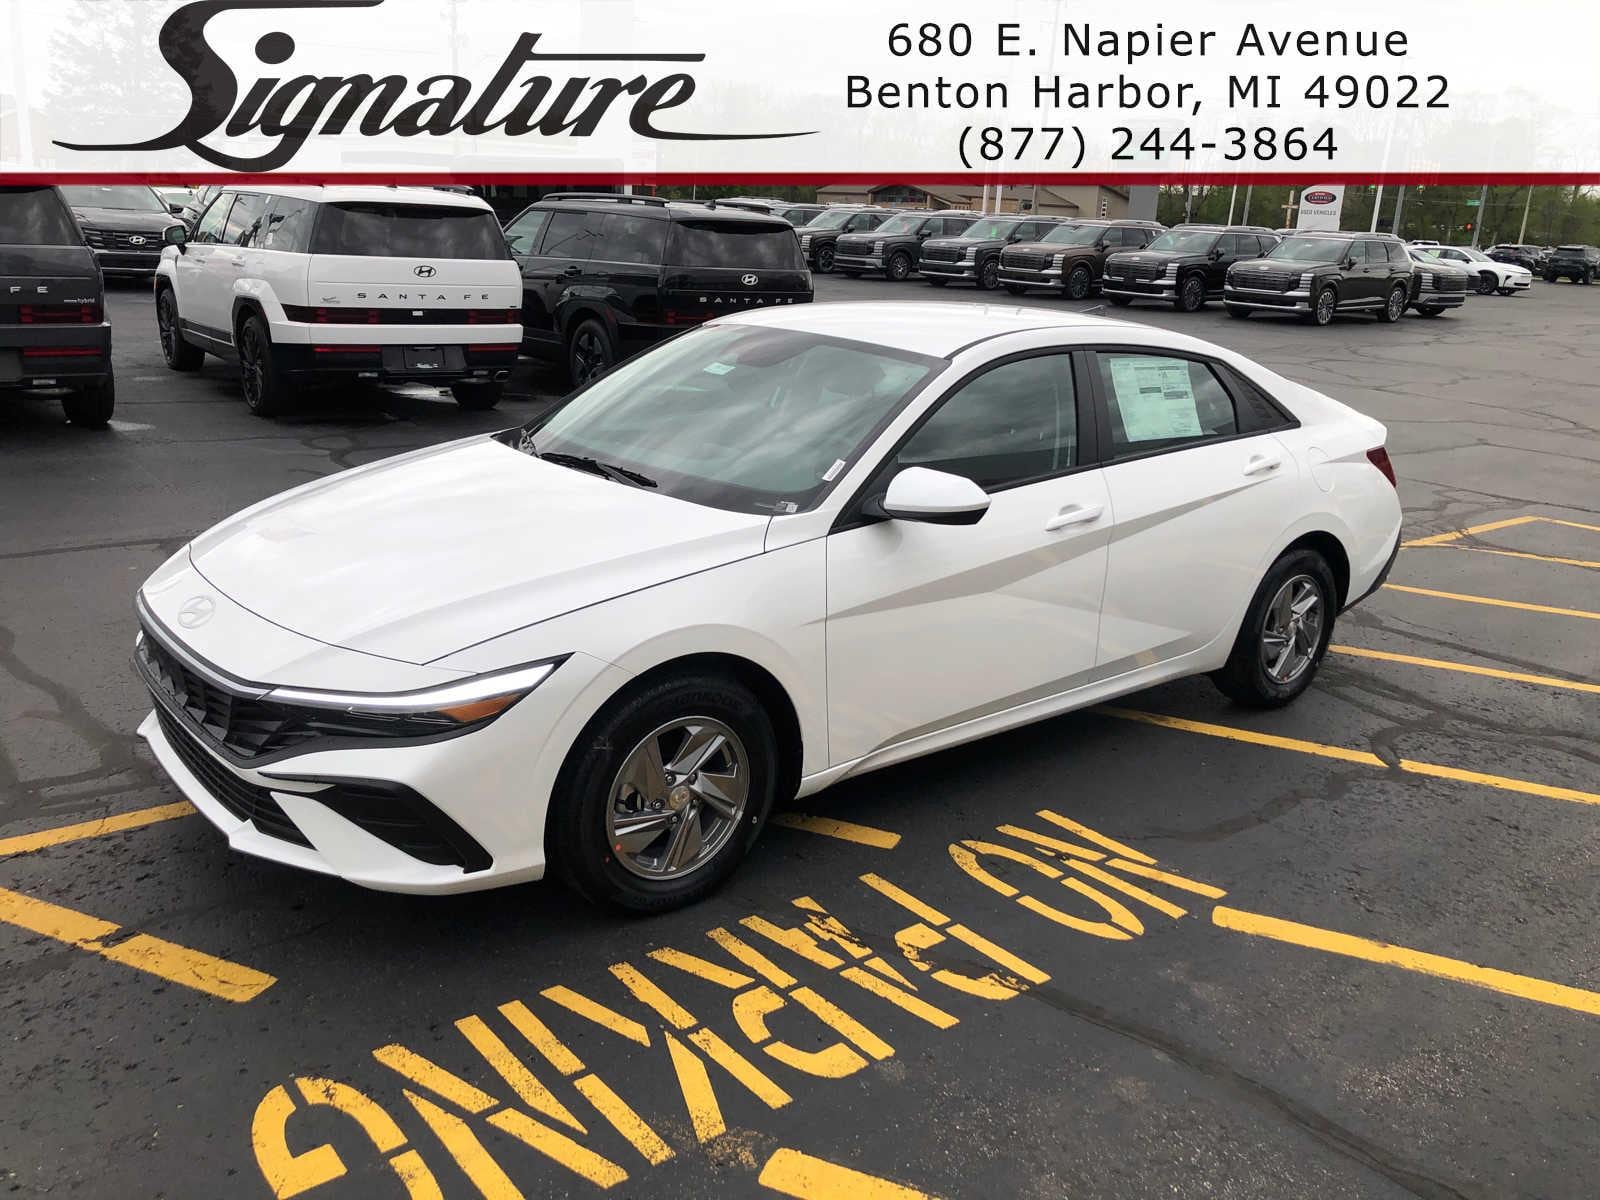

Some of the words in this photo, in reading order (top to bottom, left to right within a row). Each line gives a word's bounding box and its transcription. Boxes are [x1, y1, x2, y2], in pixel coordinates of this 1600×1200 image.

[9, 286, 48, 294] FE
[356, 292, 447, 301] SANTA
[699, 296, 765, 304] SANTA
[949, 809, 1228, 941] NO
[252, 872, 1050, 1200] PARKING
